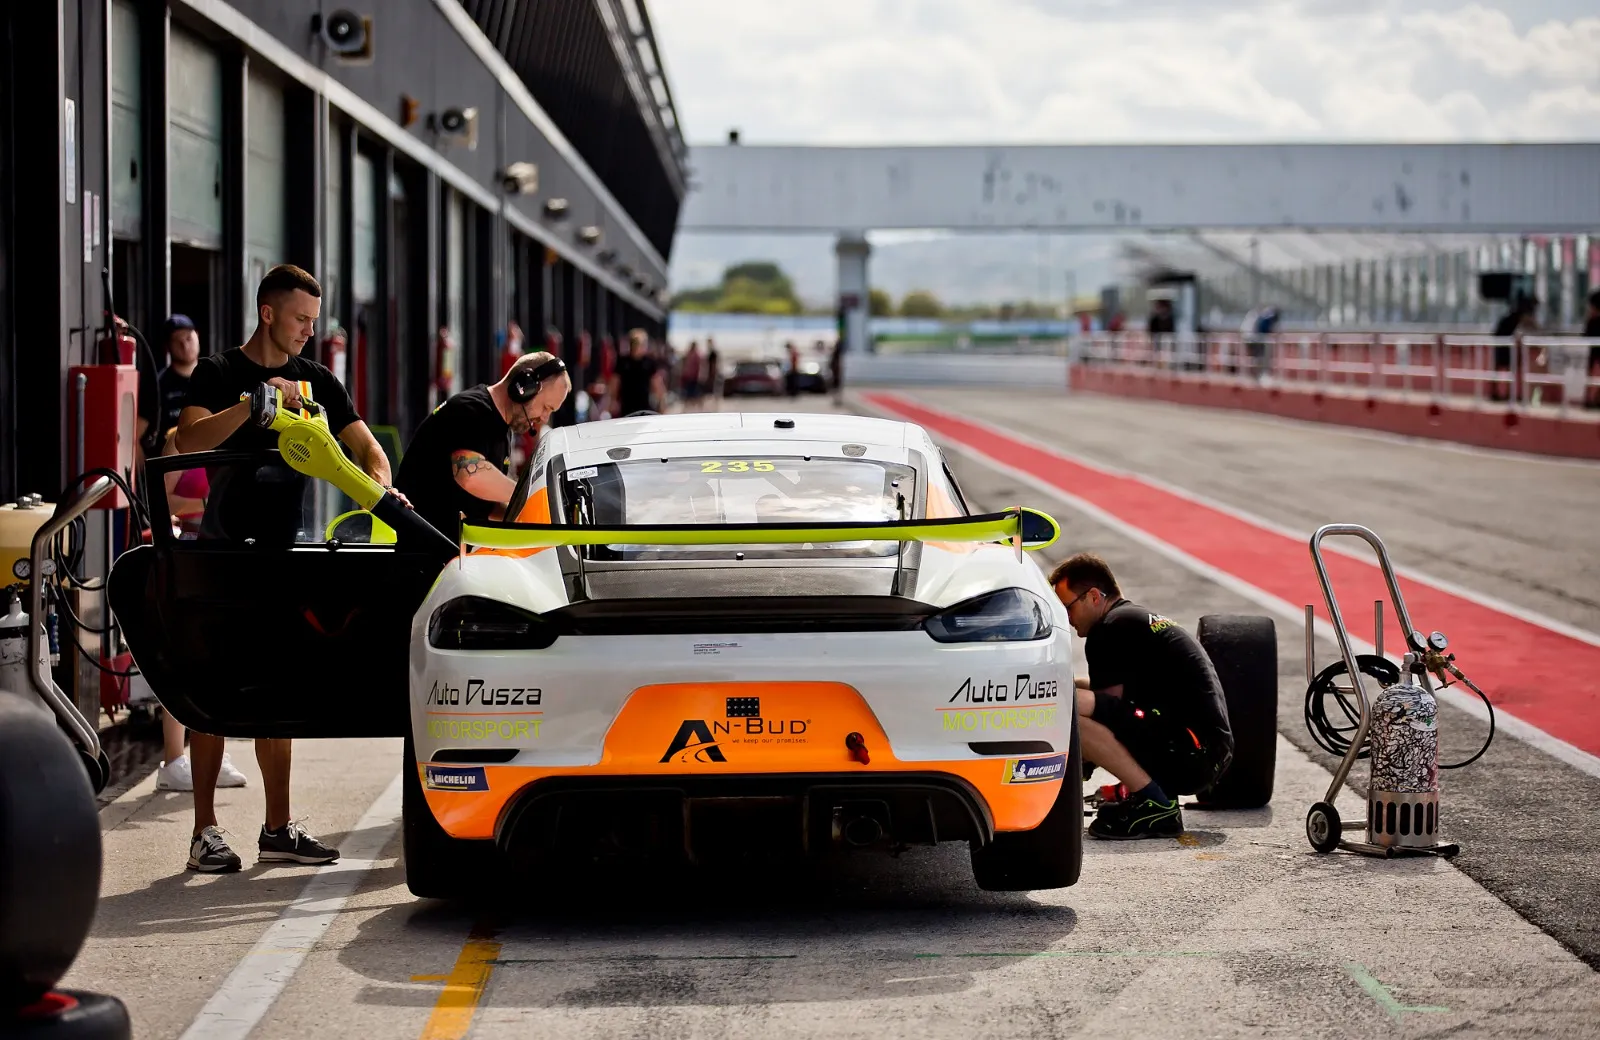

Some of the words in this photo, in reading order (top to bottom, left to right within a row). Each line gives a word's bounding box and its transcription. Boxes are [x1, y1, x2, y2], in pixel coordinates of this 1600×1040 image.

[700, 460, 775, 474] 235
[466, 679, 542, 706] Dusza
[1014, 674, 1058, 701] Dusza
[427, 719, 544, 741] MOTORSPORT
[943, 707, 1057, 731] MOTORSPORT
[435, 774, 475, 784] MICHELIN
[1027, 763, 1062, 776] MICHELIN
